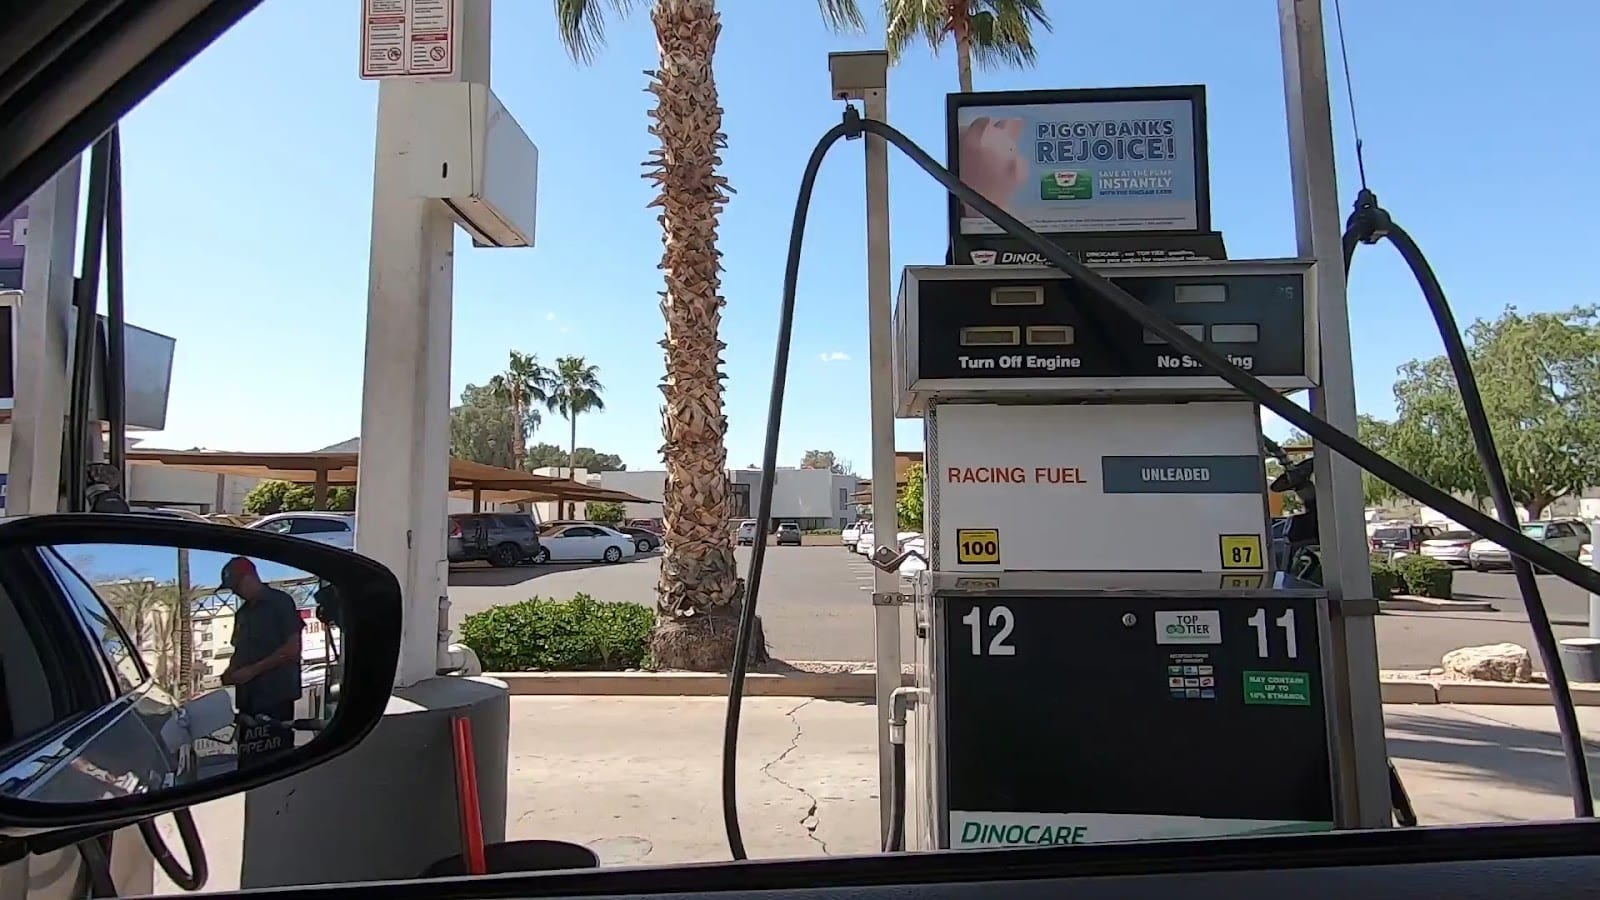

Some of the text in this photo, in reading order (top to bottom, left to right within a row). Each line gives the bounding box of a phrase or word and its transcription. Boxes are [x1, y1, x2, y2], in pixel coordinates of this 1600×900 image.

[1037, 120, 1174, 138] PIGGY BANKS
[1037, 138, 1174, 162] REJOICE!
[1099, 177, 1172, 189] INSTANTLY
[958, 355, 1081, 370] Turn Off Engine
[1157, 355, 1180, 368] No
[948, 467, 1210, 484] RACING FUEL UNLEADED
[962, 541, 996, 556] 100
[1232, 546, 1252, 563] 87
[1176, 615, 1199, 624] TOP
[962, 605, 1016, 656] 12
[1185, 624, 1210, 634] TIER
[1247, 608, 1297, 658] 11
[1279, 684, 1289, 692] TO
[244, 725, 271, 741] ARE
[960, 821, 1088, 845] DINOCARE
